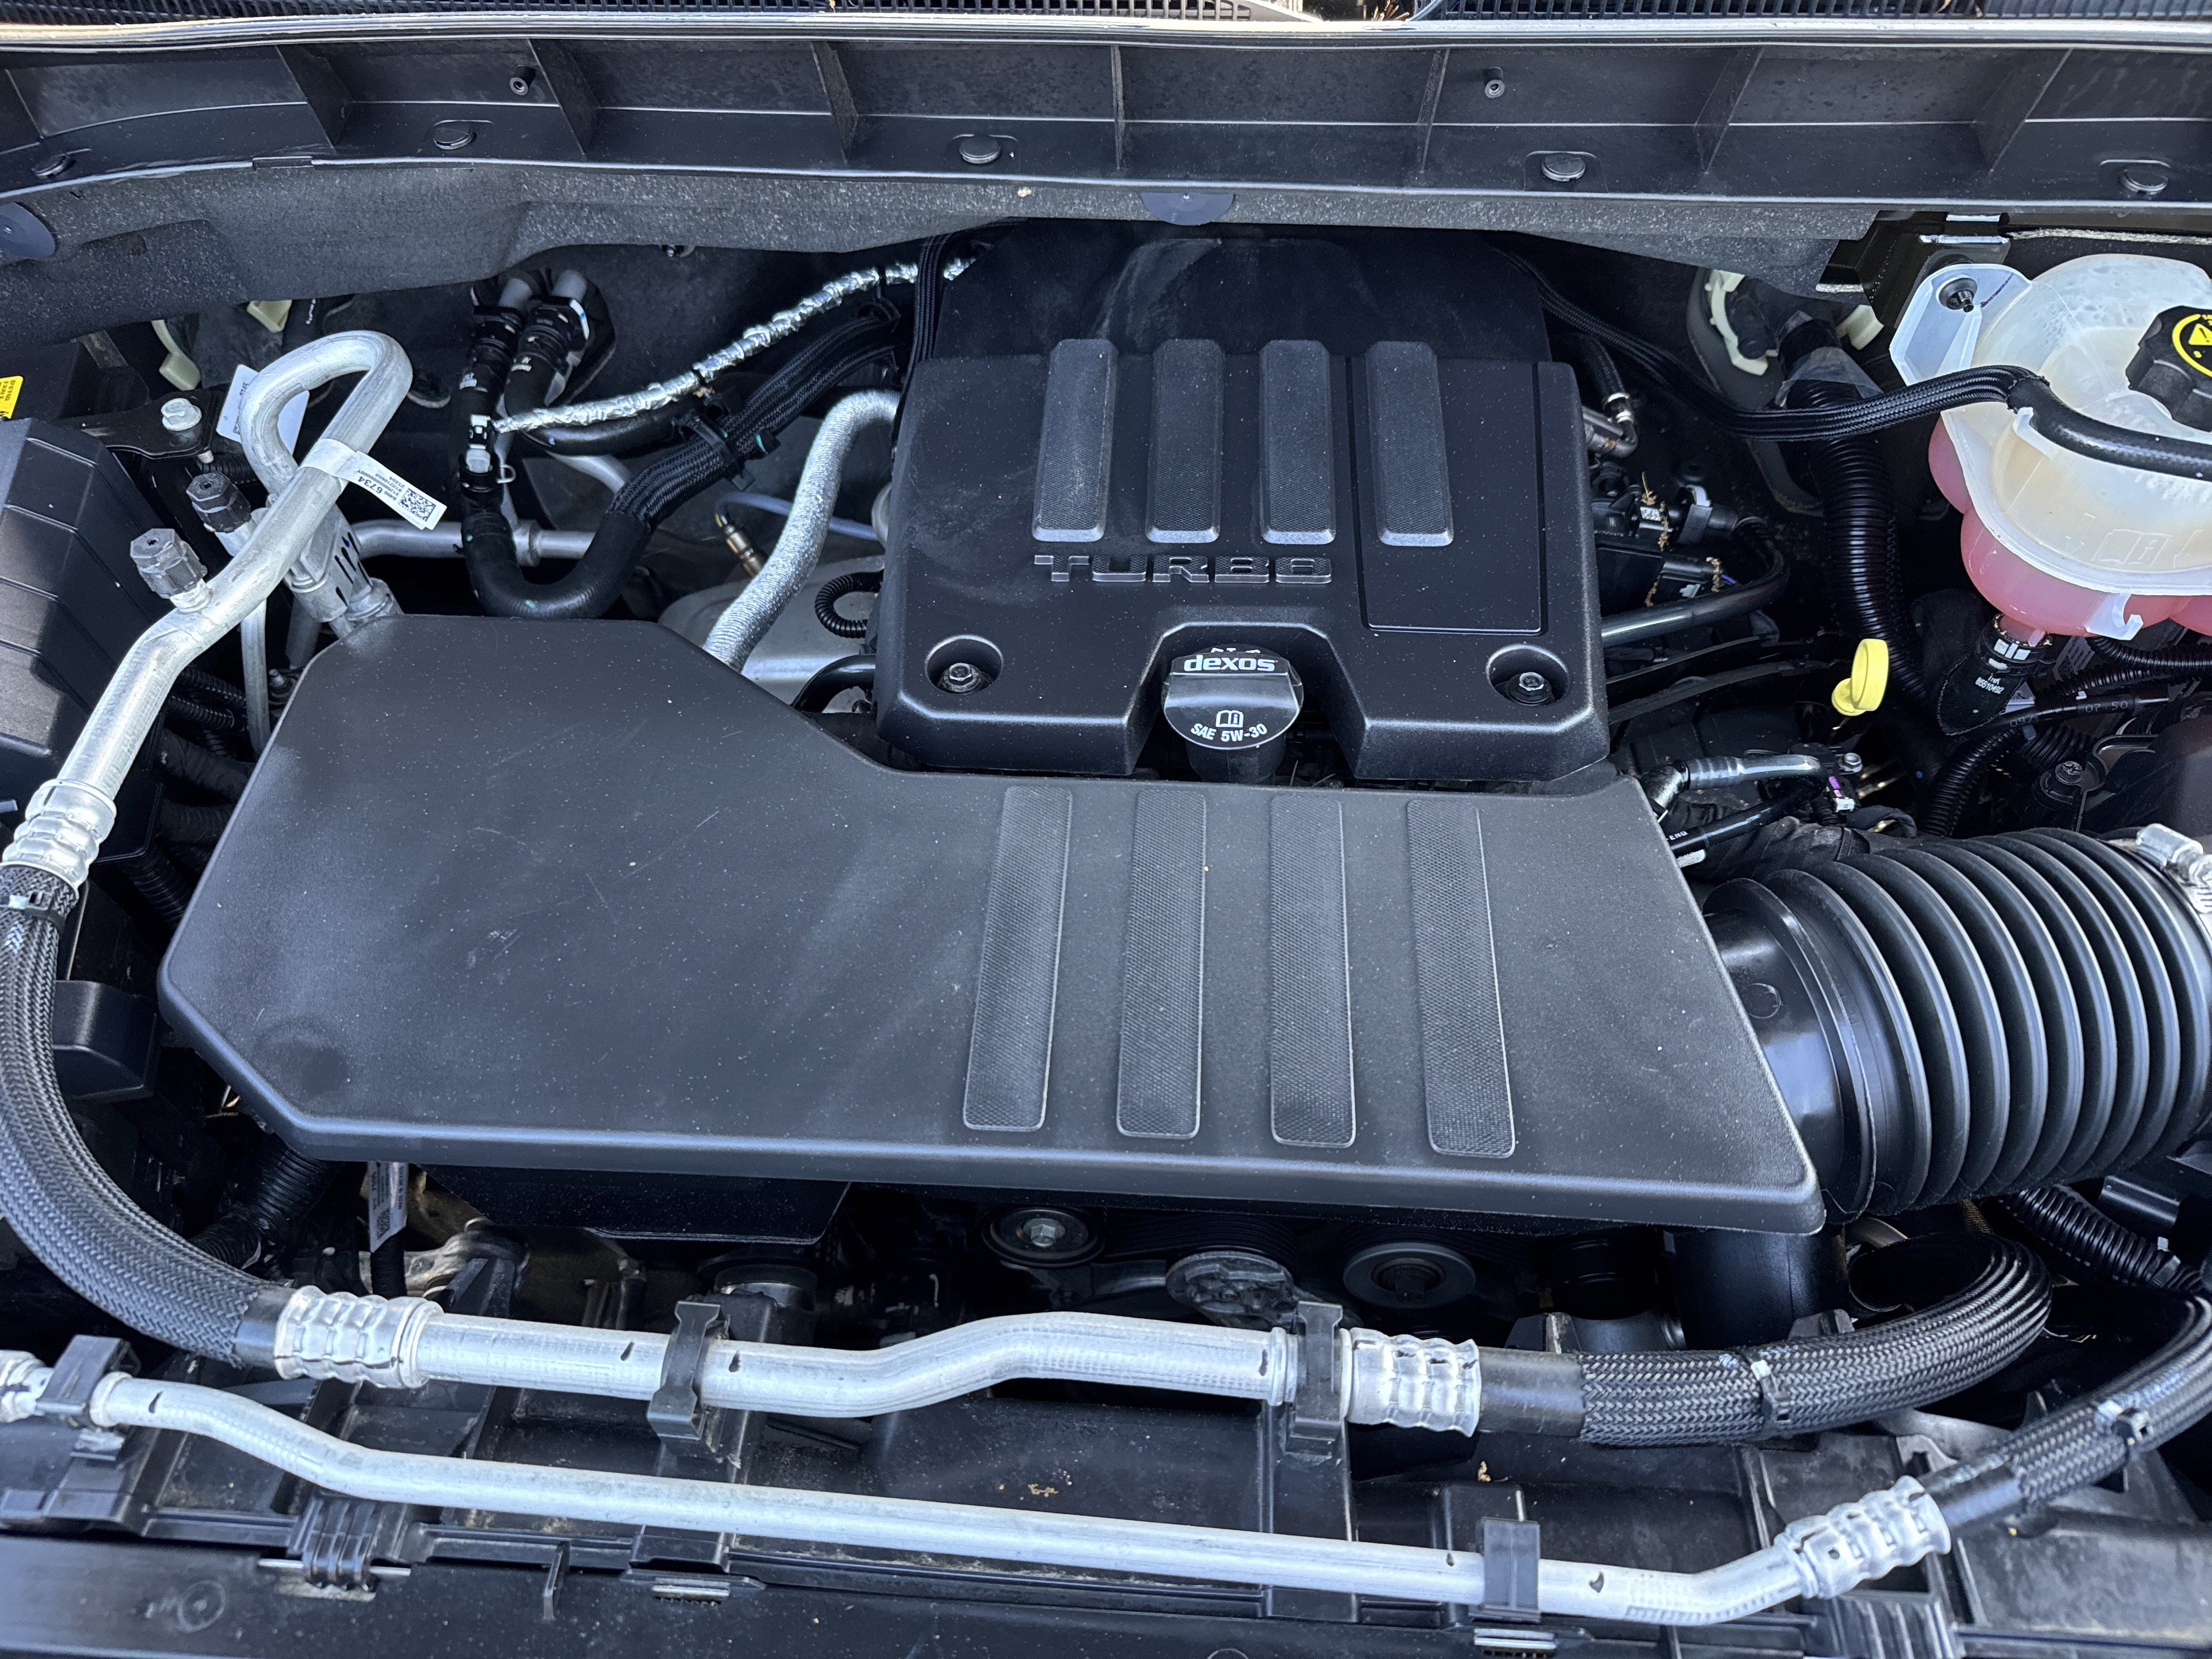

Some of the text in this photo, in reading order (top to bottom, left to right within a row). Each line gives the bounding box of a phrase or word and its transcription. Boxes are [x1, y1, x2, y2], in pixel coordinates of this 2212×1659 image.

[358, 476, 383, 494] 6734
[1034, 554, 1332, 584] TURBO
[1183, 654, 1276, 672] dexos
[1190, 723, 1267, 742] SAE 5W-30
